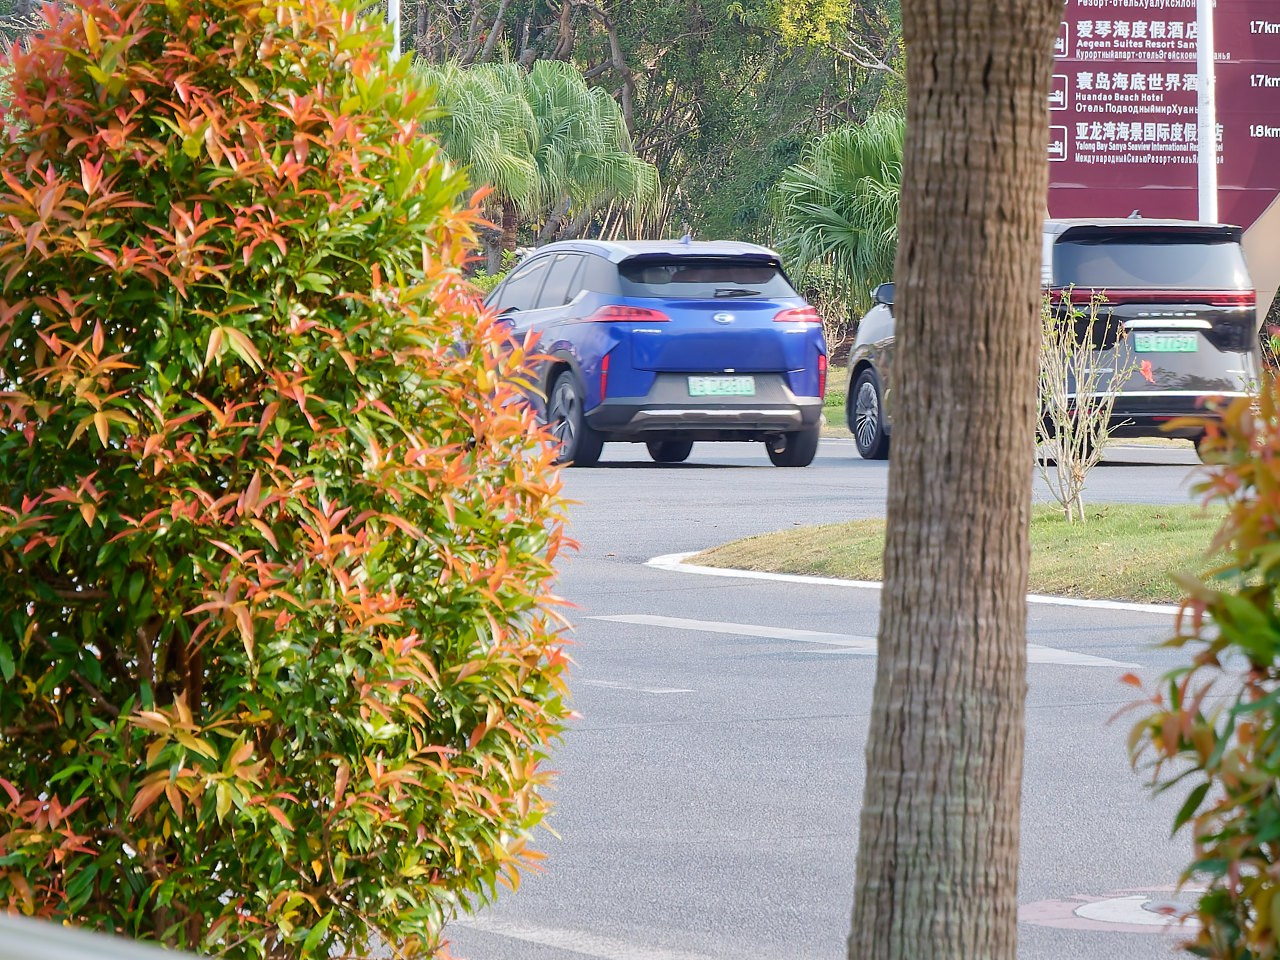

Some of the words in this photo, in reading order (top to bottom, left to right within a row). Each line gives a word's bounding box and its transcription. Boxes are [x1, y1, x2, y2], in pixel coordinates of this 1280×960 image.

[1076, 20, 1198, 39] 爱琴海度假酒店
[1076, 40, 1111, 50] Aegean
[1113, 40, 1143, 48] Suites
[1145, 40, 1175, 48] Resort
[1177, 40, 1198, 49] Sany
[1076, 72, 1216, 91] 寰岛海底世界酒
[1075, 93, 1113, 102] Huandao
[1114, 93, 1139, 102] Beach
[1141, 93, 1164, 102] Hotel
[1075, 122, 1224, 142] 亚龙湾海景国际度假店
[1075, 142, 1096, 152] Yalong
[1096, 142, 1107, 152] Bay
[1108, 142, 1127, 152] Sanya
[1127, 142, 1150, 151] Seaview
[1151, 142, 1189, 151] International
